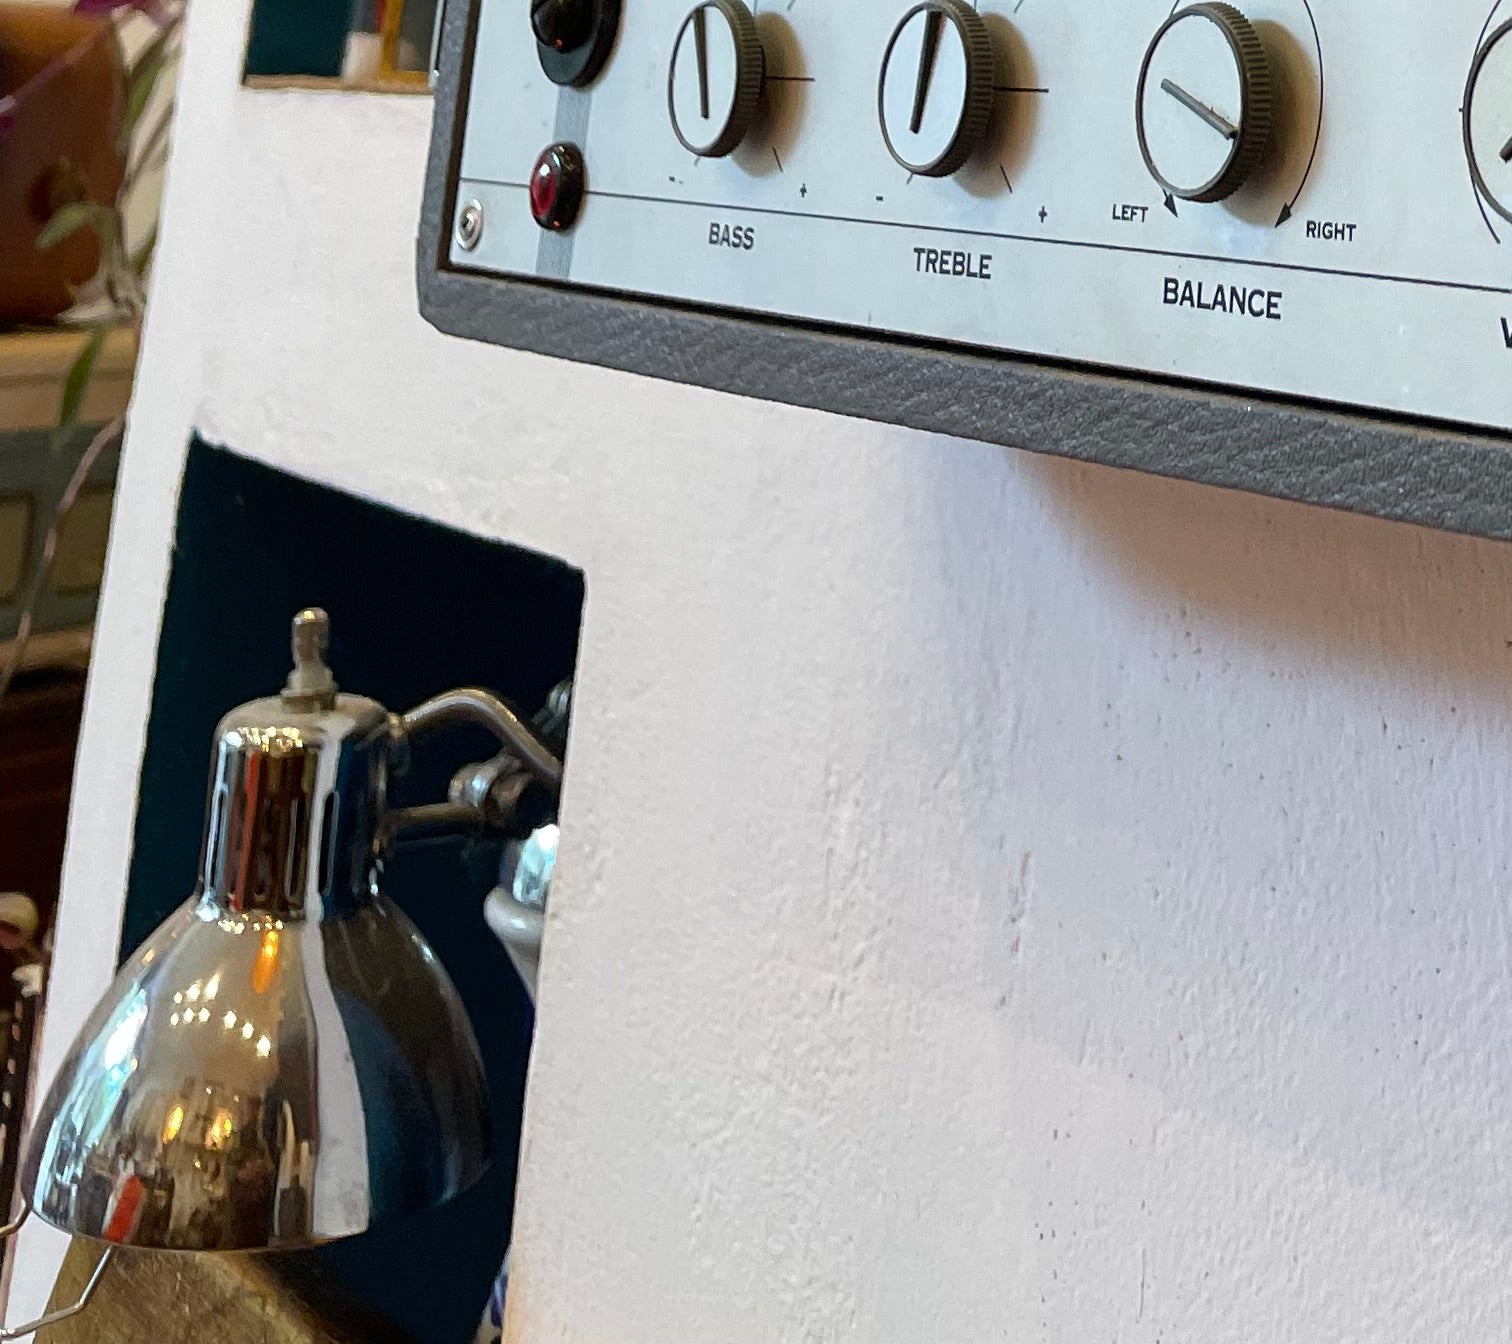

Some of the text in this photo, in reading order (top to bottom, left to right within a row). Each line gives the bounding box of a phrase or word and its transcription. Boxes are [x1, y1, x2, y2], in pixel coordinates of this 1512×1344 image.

[1111, 203, 1149, 223] LEFT
[708, 221, 755, 251] BASS
[1305, 219, 1357, 242] RIGHT
[913, 246, 993, 280] TREBLE
[1162, 276, 1283, 321] BALANCE
